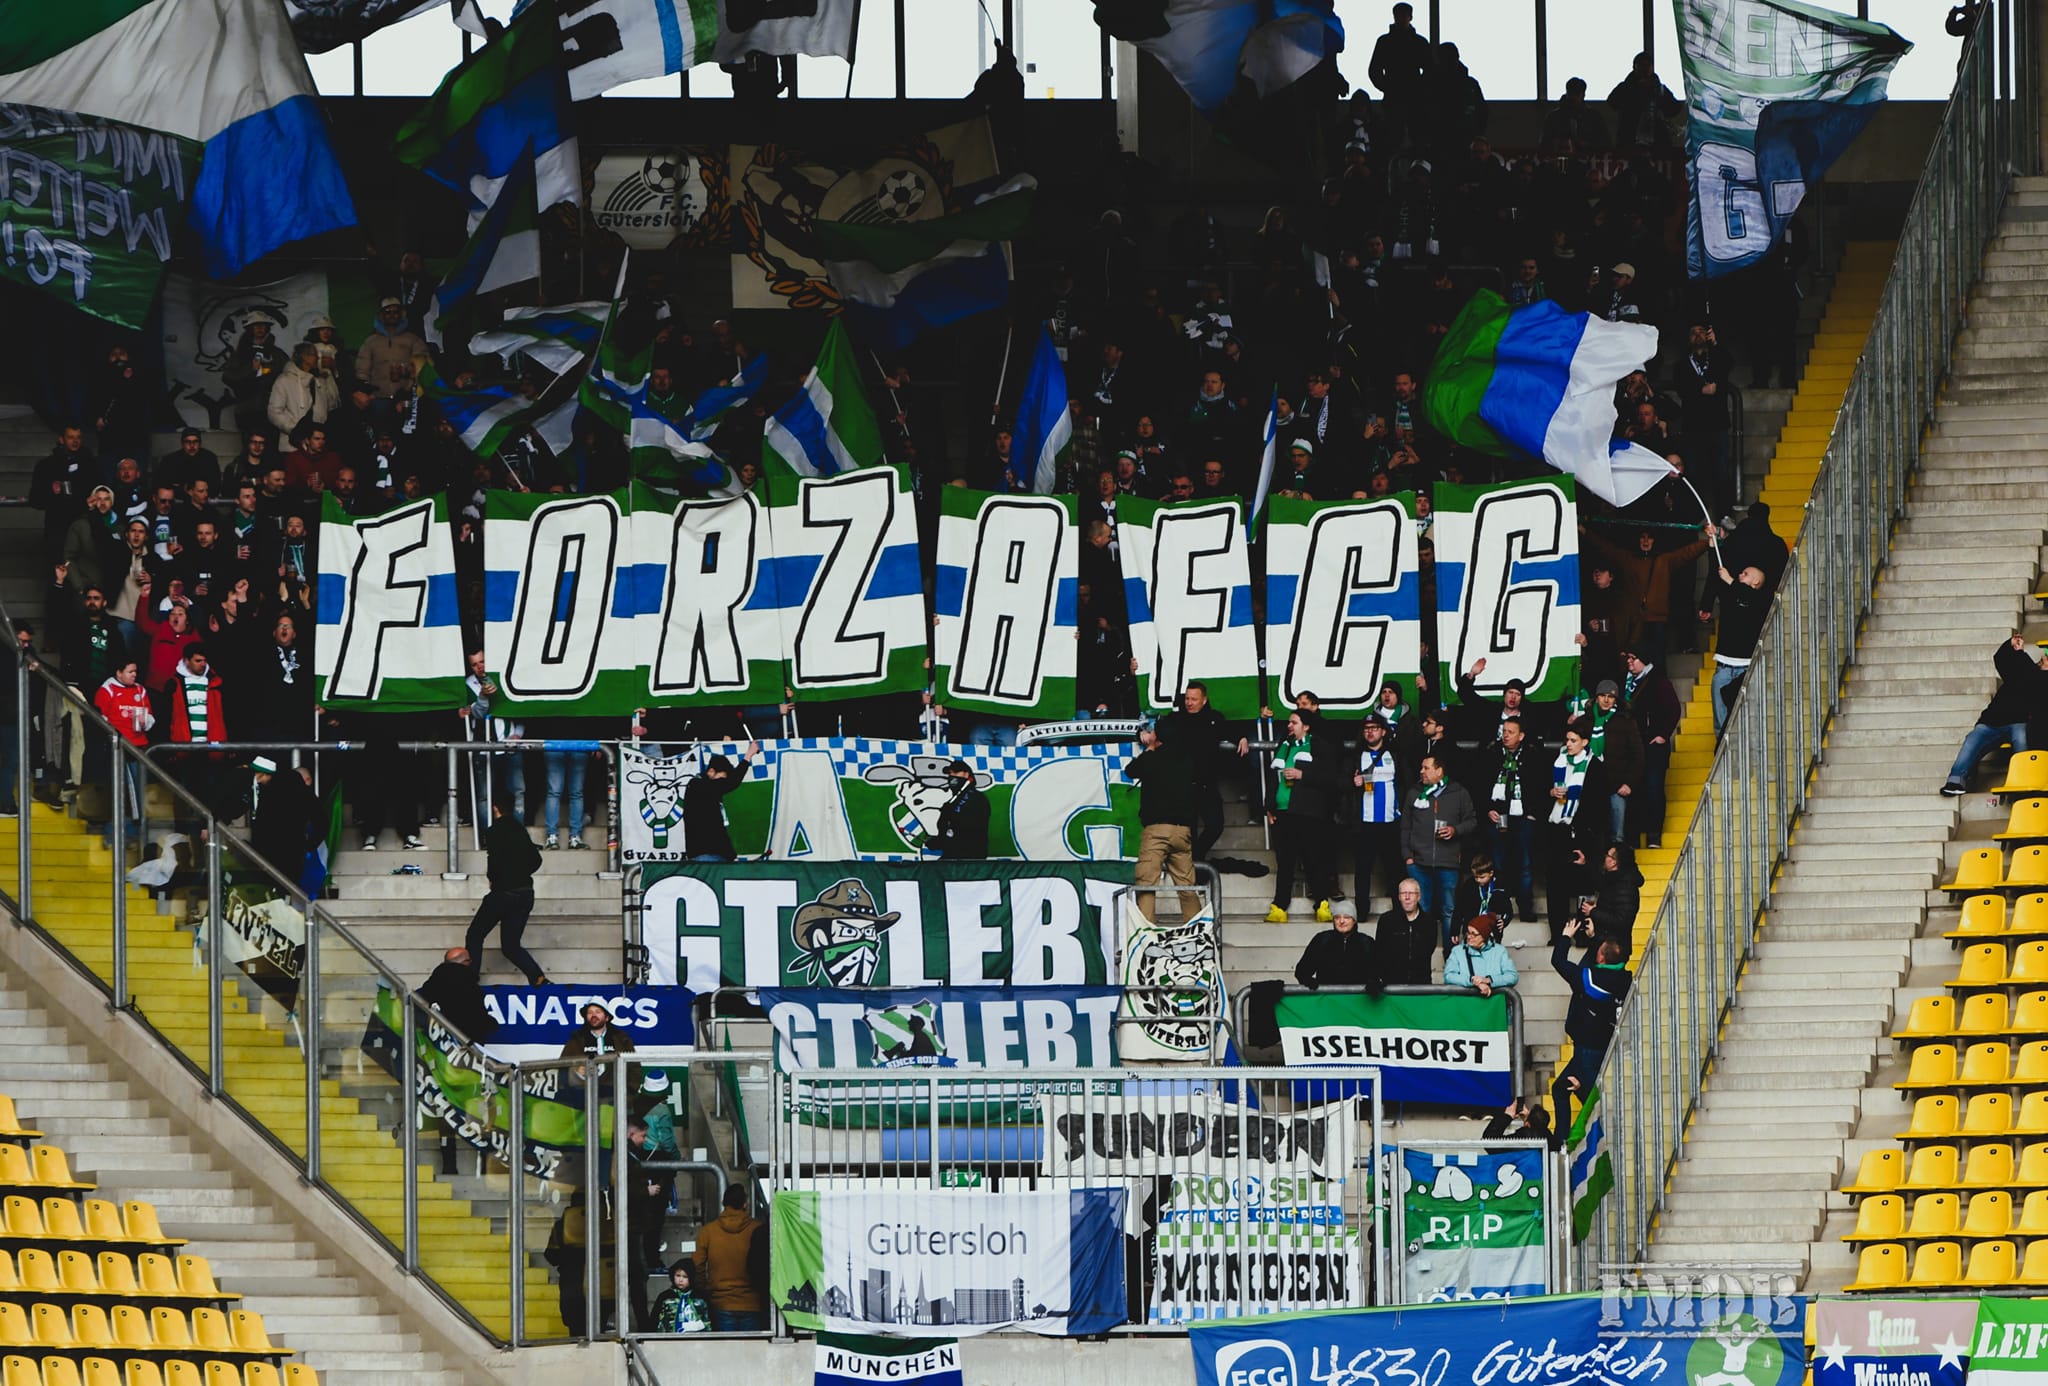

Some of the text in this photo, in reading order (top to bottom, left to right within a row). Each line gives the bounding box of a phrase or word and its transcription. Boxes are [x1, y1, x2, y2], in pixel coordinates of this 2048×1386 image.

[1684, 0, 1850, 77] SZEN
[660, 194, 697, 210] F.C.
[599, 211, 694, 227] Gütersloh
[322, 466, 1564, 711] FORZA FCG
[1029, 725, 1071, 737] AKTIVE
[624, 753, 697, 766] VECCHIA
[641, 876, 798, 993] GT
[484, 994, 658, 1028] ANATCS
[768, 996, 1120, 1076] GT LEBT
[1303, 1035, 1489, 1064] ISSELHORST
[1025, 1083, 1067, 1093] SPPRT
[1057, 1112, 1329, 1167] SUNDERN
[1170, 1176, 1230, 1206] PRO
[1173, 1211, 1207, 1223] KEIN
[1430, 1214, 1503, 1242] R.I.P
[867, 1223, 1027, 1256] Gütersloh
[1161, 1252, 1350, 1302] MINDEN
[827, 1349, 955, 1377] MÜNCHEN
[1231, 1366, 1288, 1386] FCG
[1310, 1337, 1668, 1386] 4830 Gütersloh
